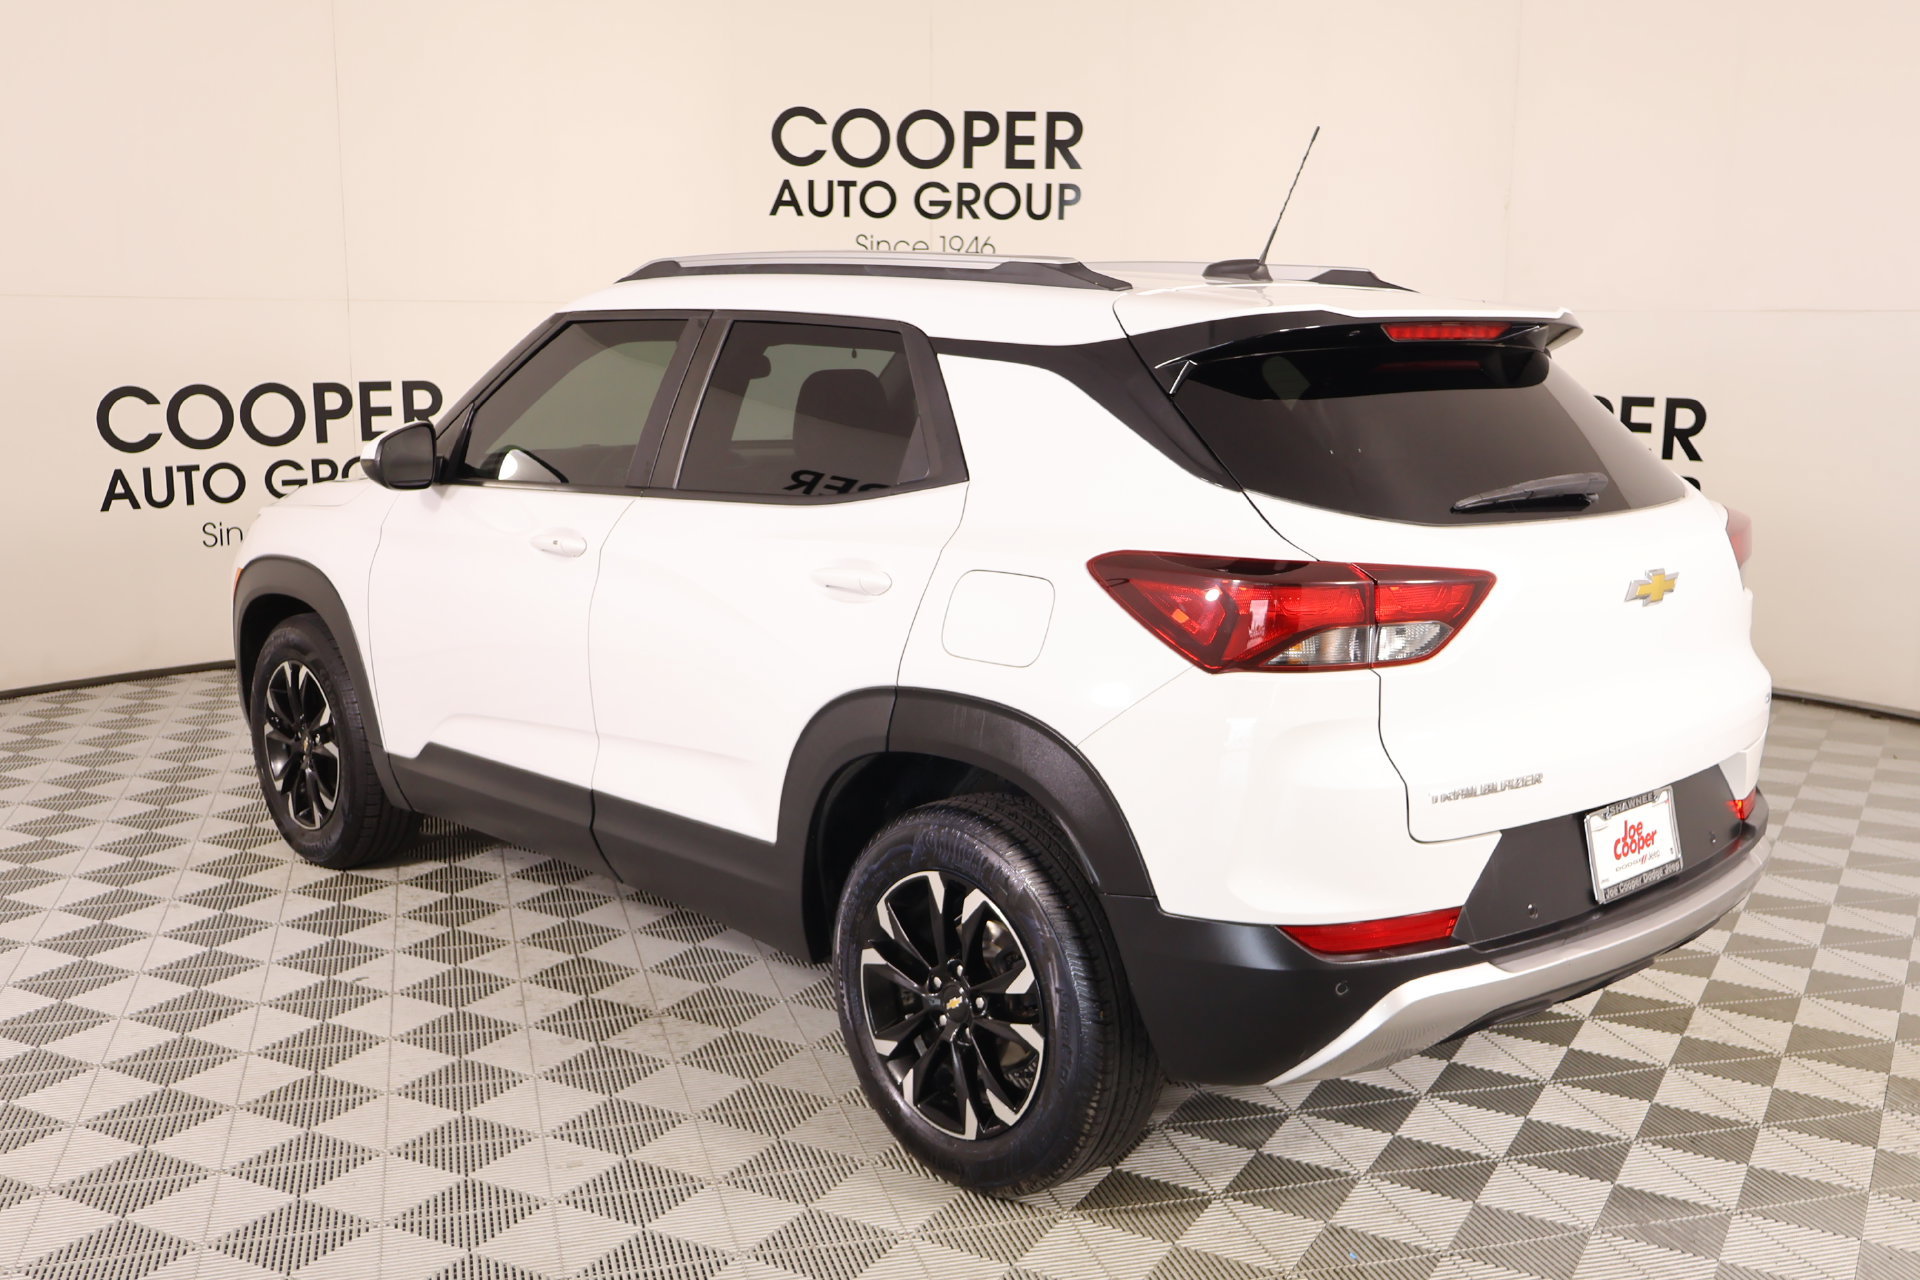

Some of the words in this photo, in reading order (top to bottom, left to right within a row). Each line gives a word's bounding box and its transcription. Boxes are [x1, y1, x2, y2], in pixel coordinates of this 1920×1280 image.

[771, 106, 1084, 170] COOPER
[769, 179, 897, 219] AUTO
[914, 181, 1081, 220] GROUP
[100, 462, 246, 512] AUTO
[1613, 829, 1658, 861] Cooper
[1621, 820, 1643, 842] Joe
[1604, 888, 1618, 900] Joe
